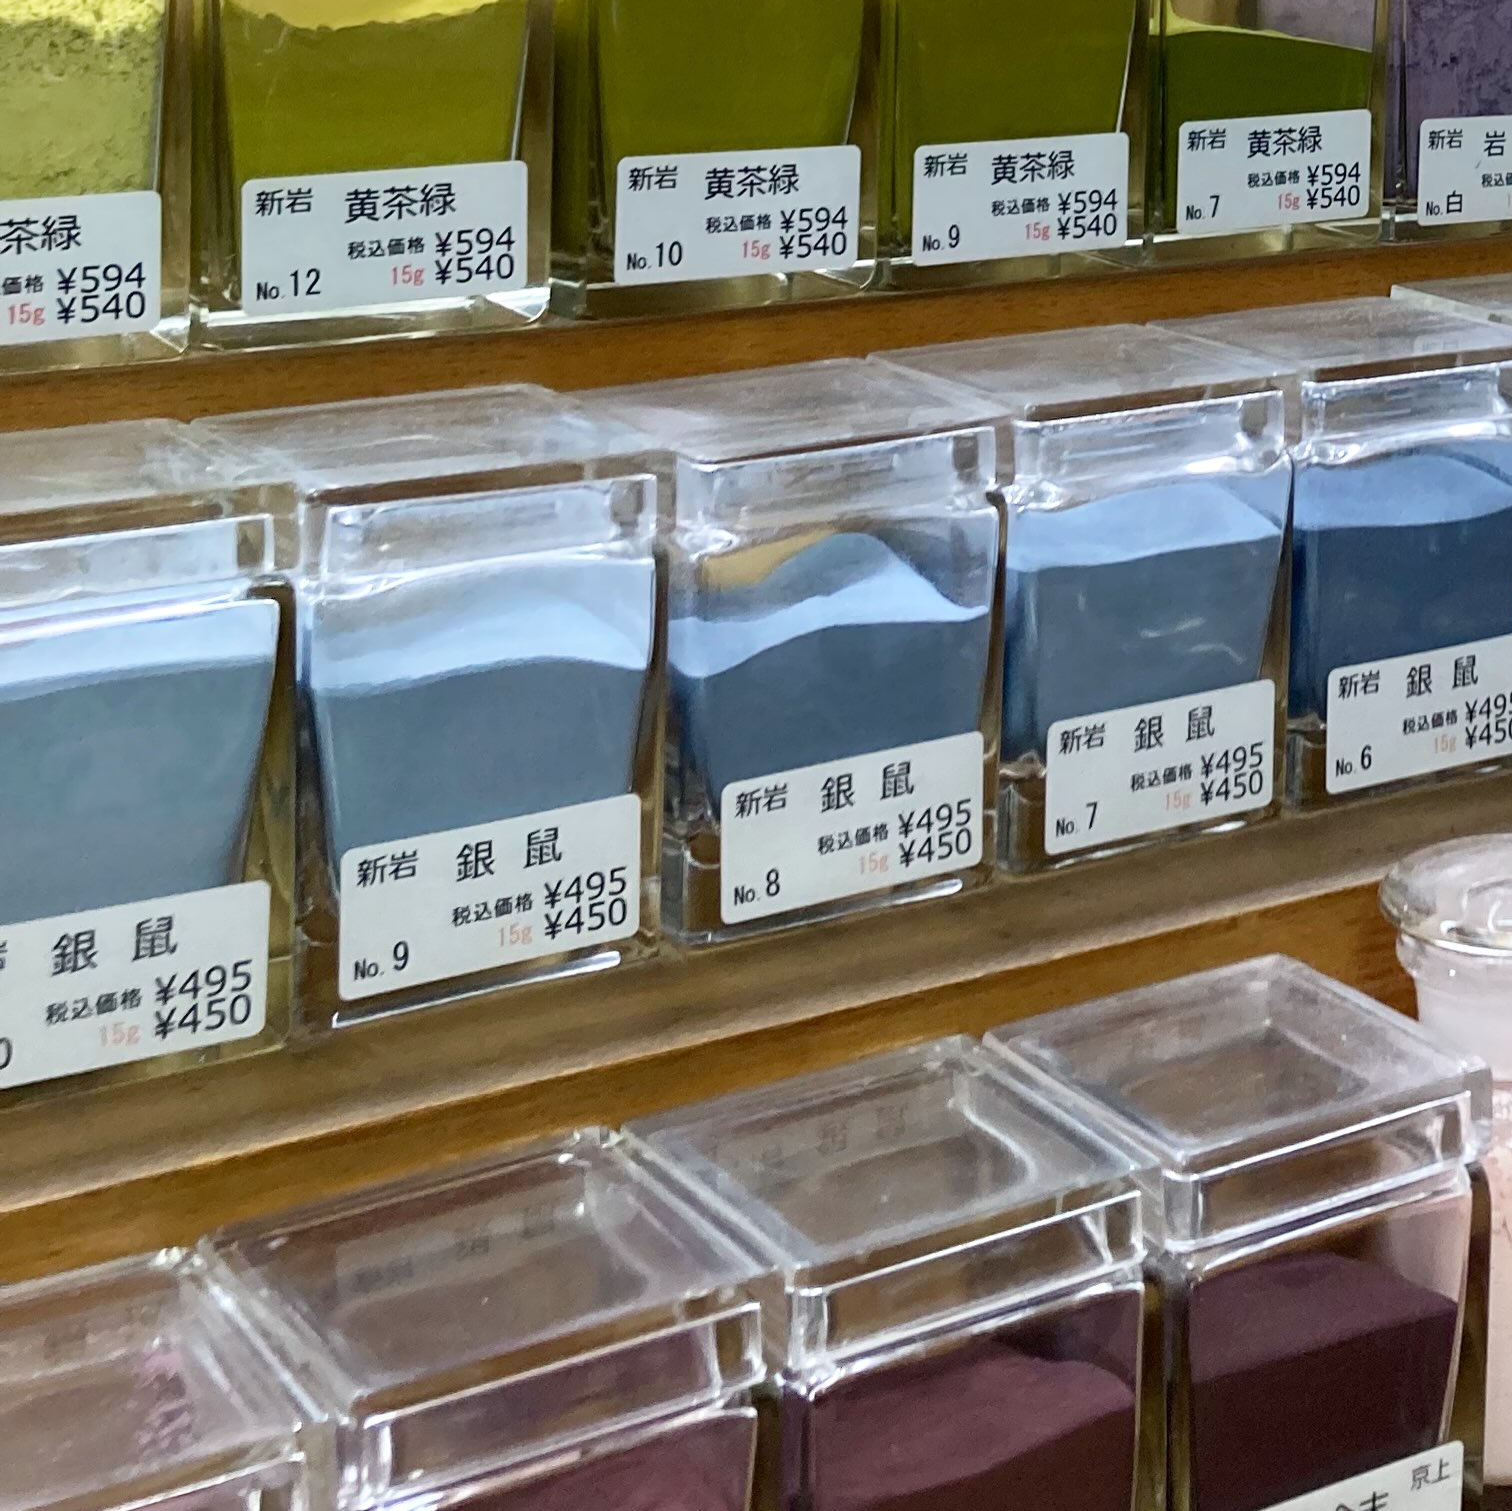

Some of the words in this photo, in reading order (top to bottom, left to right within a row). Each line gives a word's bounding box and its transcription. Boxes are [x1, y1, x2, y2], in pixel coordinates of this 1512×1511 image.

[1246, 124, 1322, 159] 黄茶緑
[1427, 127, 1463, 150] 新岩
[627, 164, 678, 191] 新岩
[703, 163, 799, 200] 黄茶緑
[923, 151, 968, 178] 新岩
[990, 149, 1074, 185] 黄茶緑
[1305, 161, 1361, 193] ¥594
[254, 186, 313, 216] 新岩
[344, 182, 456, 224] 黄茶緑
[1057, 187, 1118, 215] ¥594
[780, 205, 848, 234] ¥594
[1056, 213, 1117, 240] ¥540
[347, 235, 425, 259] 税込価格
[434, 225, 515, 257] ¥594
[780, 230, 847, 259] ¥540
[57, 262, 147, 295] ¥594
[434, 254, 514, 285] ¥540
[8, 302, 46, 326] 15g
[56, 290, 146, 324] ¥540
[1337, 669, 1380, 700] 新岩
[897, 797, 971, 849] ¥495
[356, 849, 418, 887] 新岩
[451, 892, 533, 927] 税込価格
[543, 865, 627, 921] ¥495
[544, 905, 627, 940] ¥450
[45, 987, 143, 1026] 税込価格
[155, 959, 254, 1006] ¥495
[154, 993, 252, 1041] ¥450
